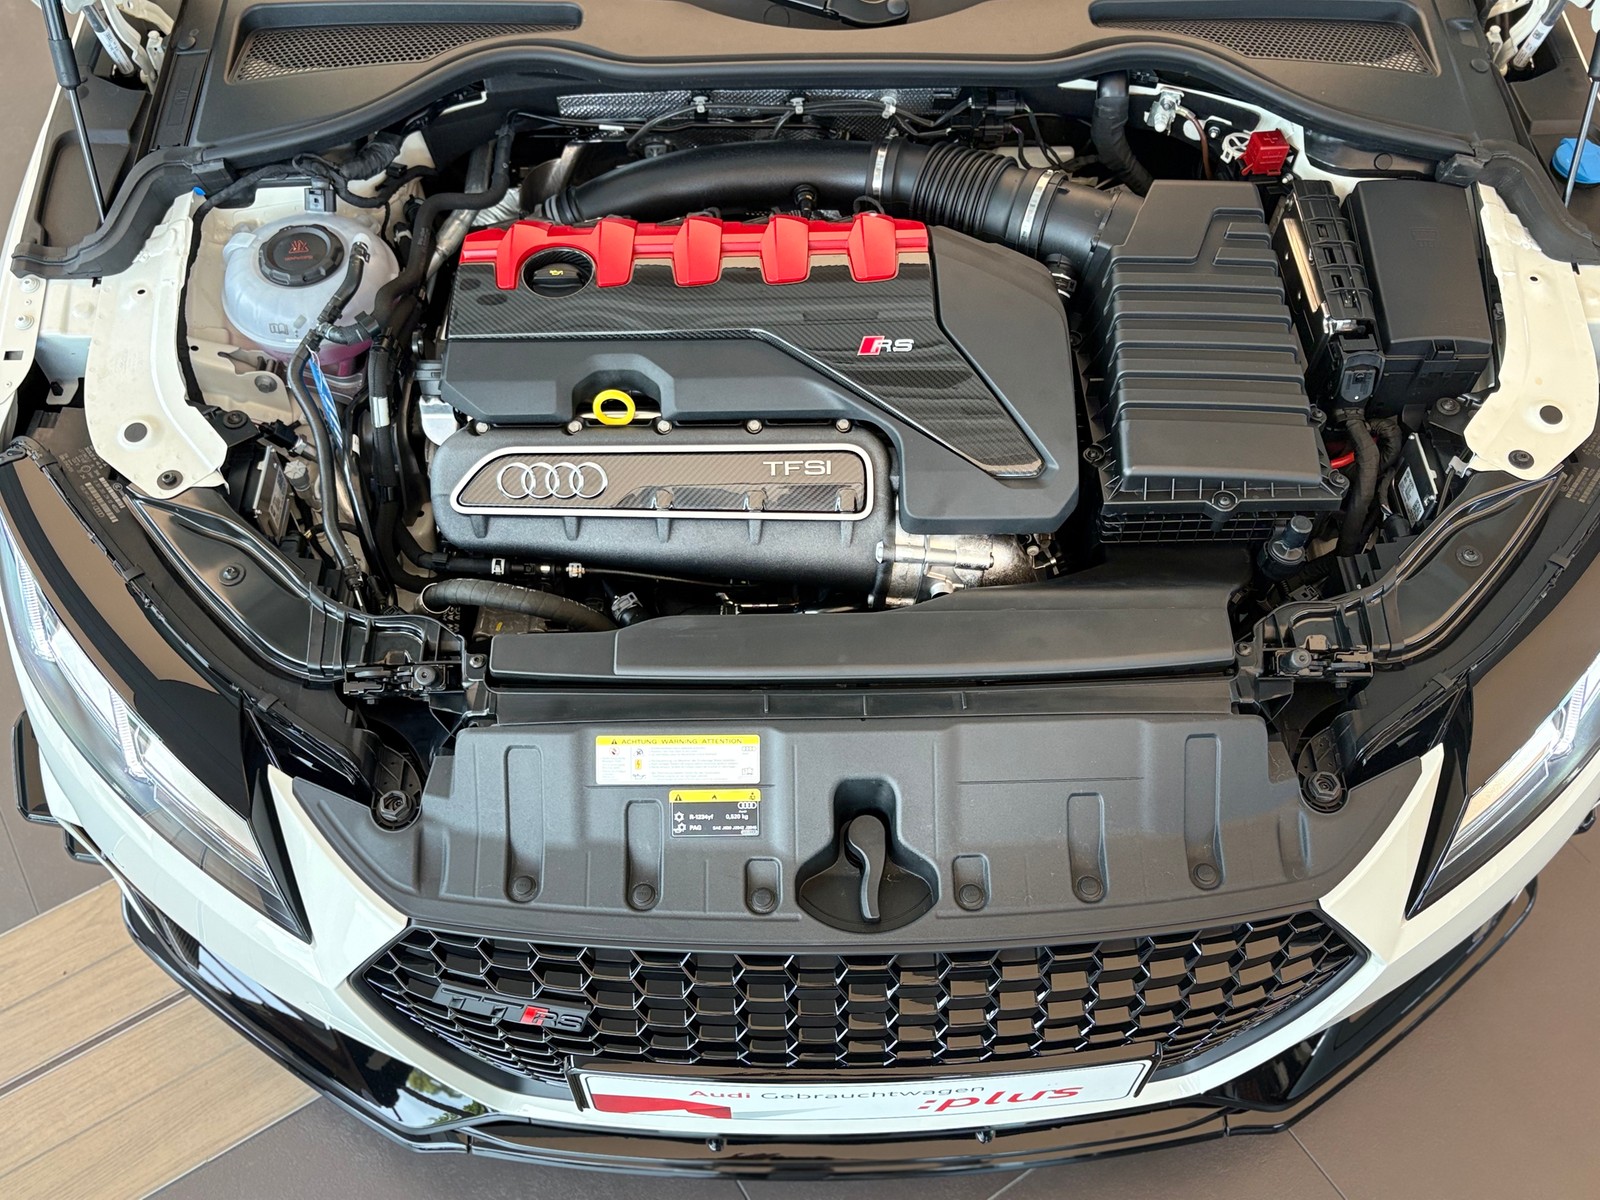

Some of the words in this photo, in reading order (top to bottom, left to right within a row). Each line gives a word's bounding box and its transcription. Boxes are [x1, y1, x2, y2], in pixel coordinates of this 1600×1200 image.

[866, 338, 914, 354] RS
[763, 460, 832, 476] TFSI
[528, 1010, 584, 1028] RS
[689, 1090, 750, 1099] Audi
[761, 1086, 985, 1100] Gebrauchtwagen
